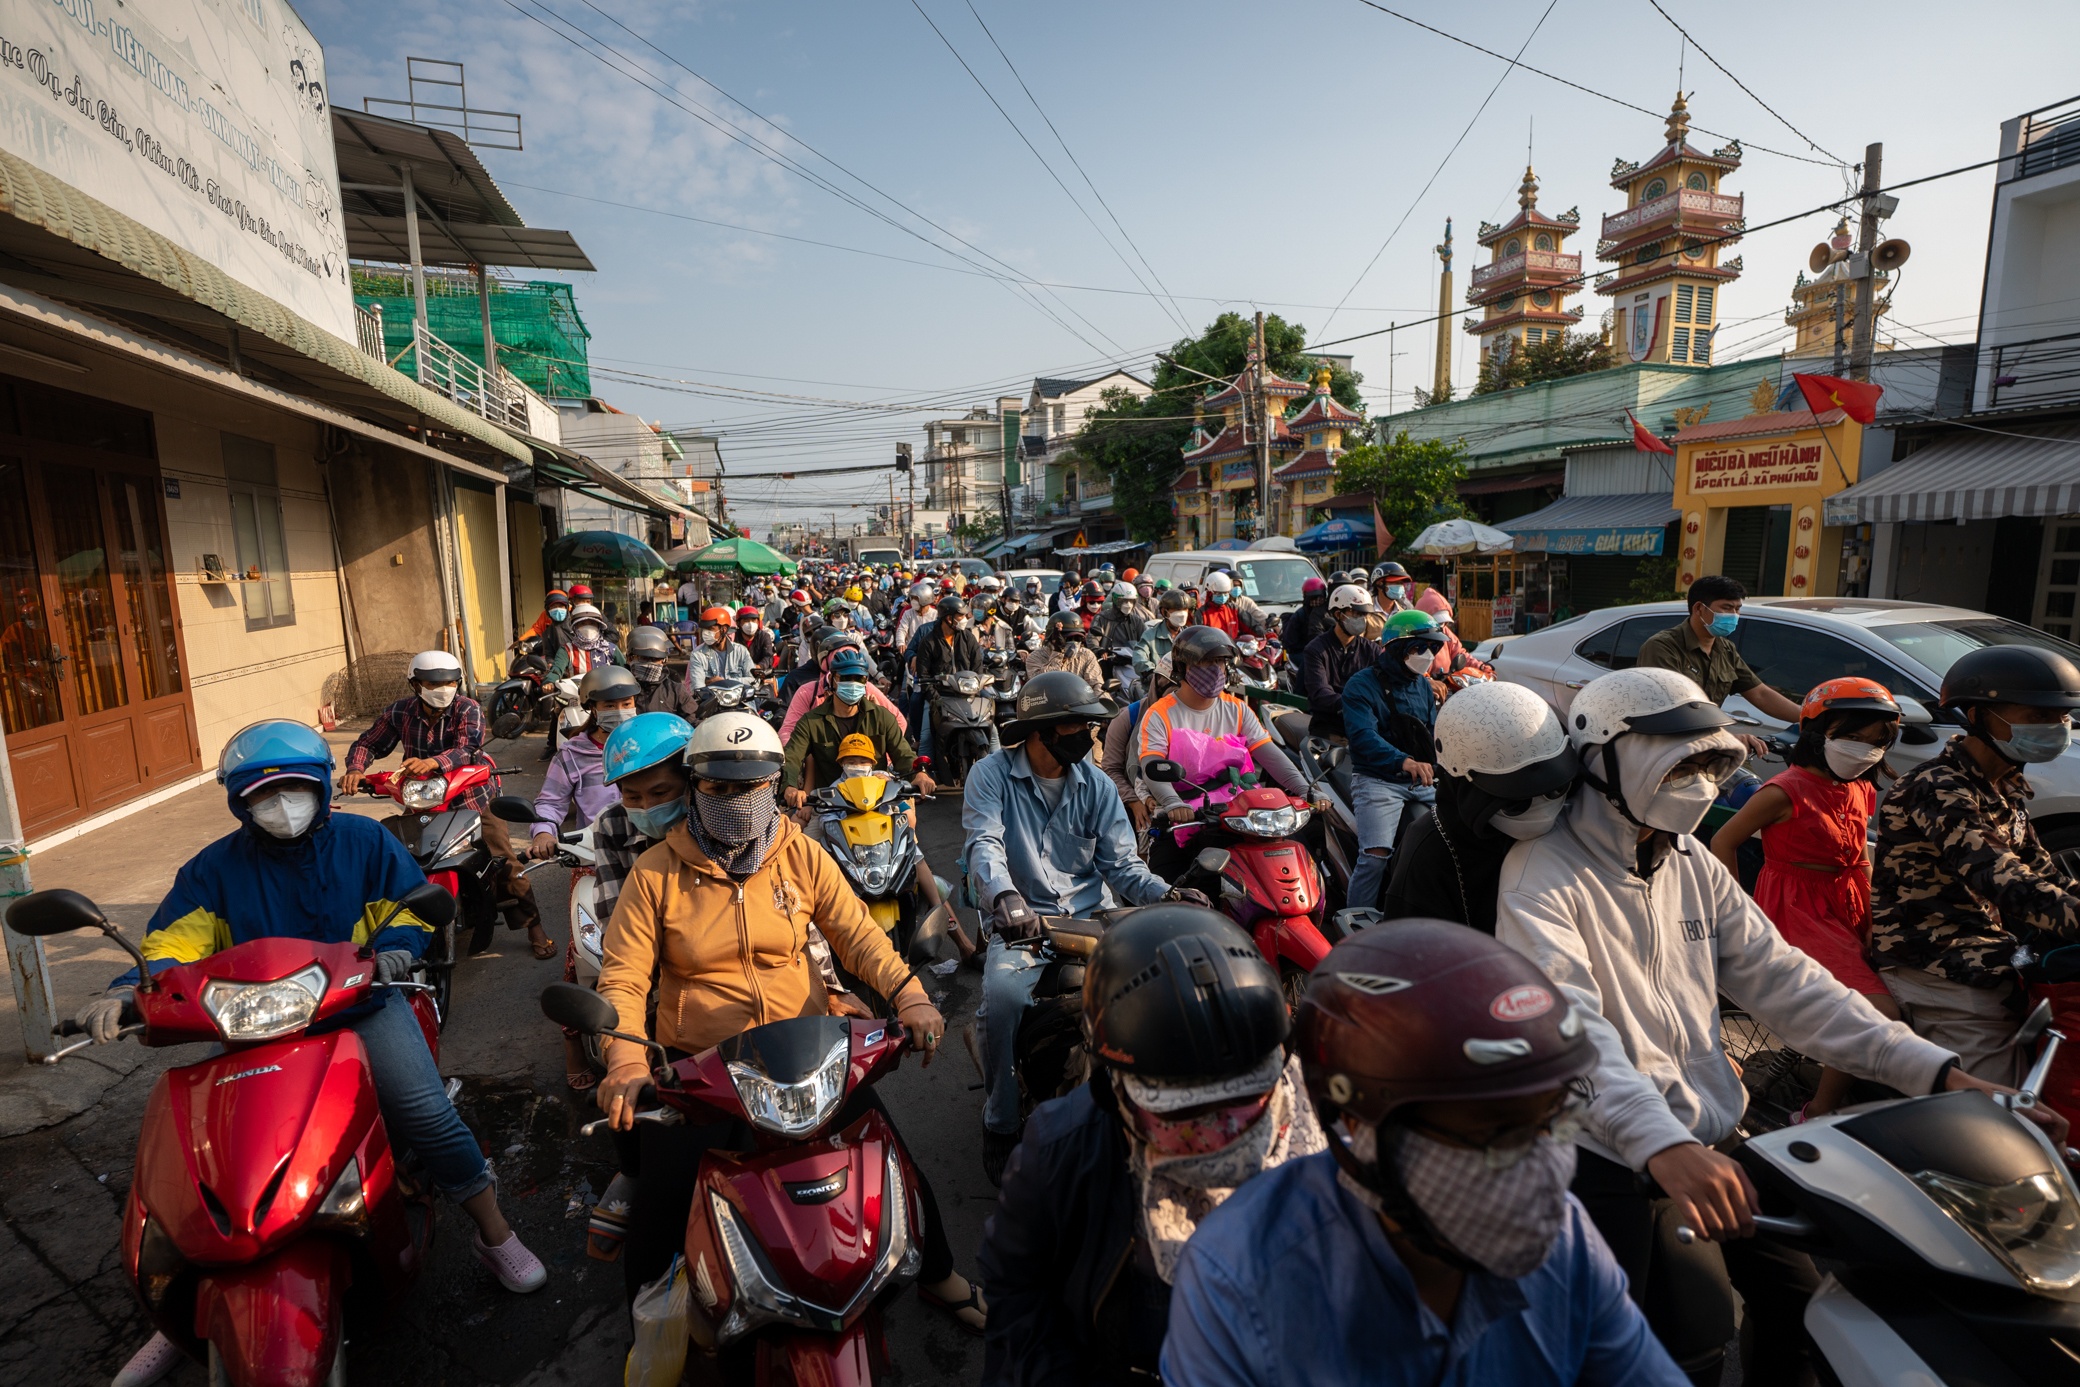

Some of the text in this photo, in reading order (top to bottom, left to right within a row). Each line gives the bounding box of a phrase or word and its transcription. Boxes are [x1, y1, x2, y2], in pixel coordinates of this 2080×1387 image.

[27, 49, 62, 100] Vụ
[109, 18, 147, 78] LIÊN
[147, 51, 190, 113] HOAN
[198, 97, 232, 148] SINH
[231, 124, 260, 172] NHẬT
[266, 156, 287, 195] TÂN
[286, 175, 304, 209] GIA
[1727, 449, 1746, 470] BÀ
[1748, 444, 1780, 468] NGŨ
[1779, 443, 1822, 466] HÀNH
[1694, 473, 1709, 489] ẤP
[1709, 472, 1730, 488] CÁT
[1730, 470, 1748, 487] LÁI
[1753, 470, 1770, 486] XÃ
[1769, 467, 1793, 484] PHÚ
[1793, 465, 1819, 482] HỮU
[1556, 535, 1586, 551] CAFE
[1594, 530, 1621, 552] GIẢI
[1622, 530, 1659, 552] KHÁT
[895, 814, 908, 829] 10
[215, 1064, 282, 1086] HONDA
[796, 1181, 843, 1197] HONDA
